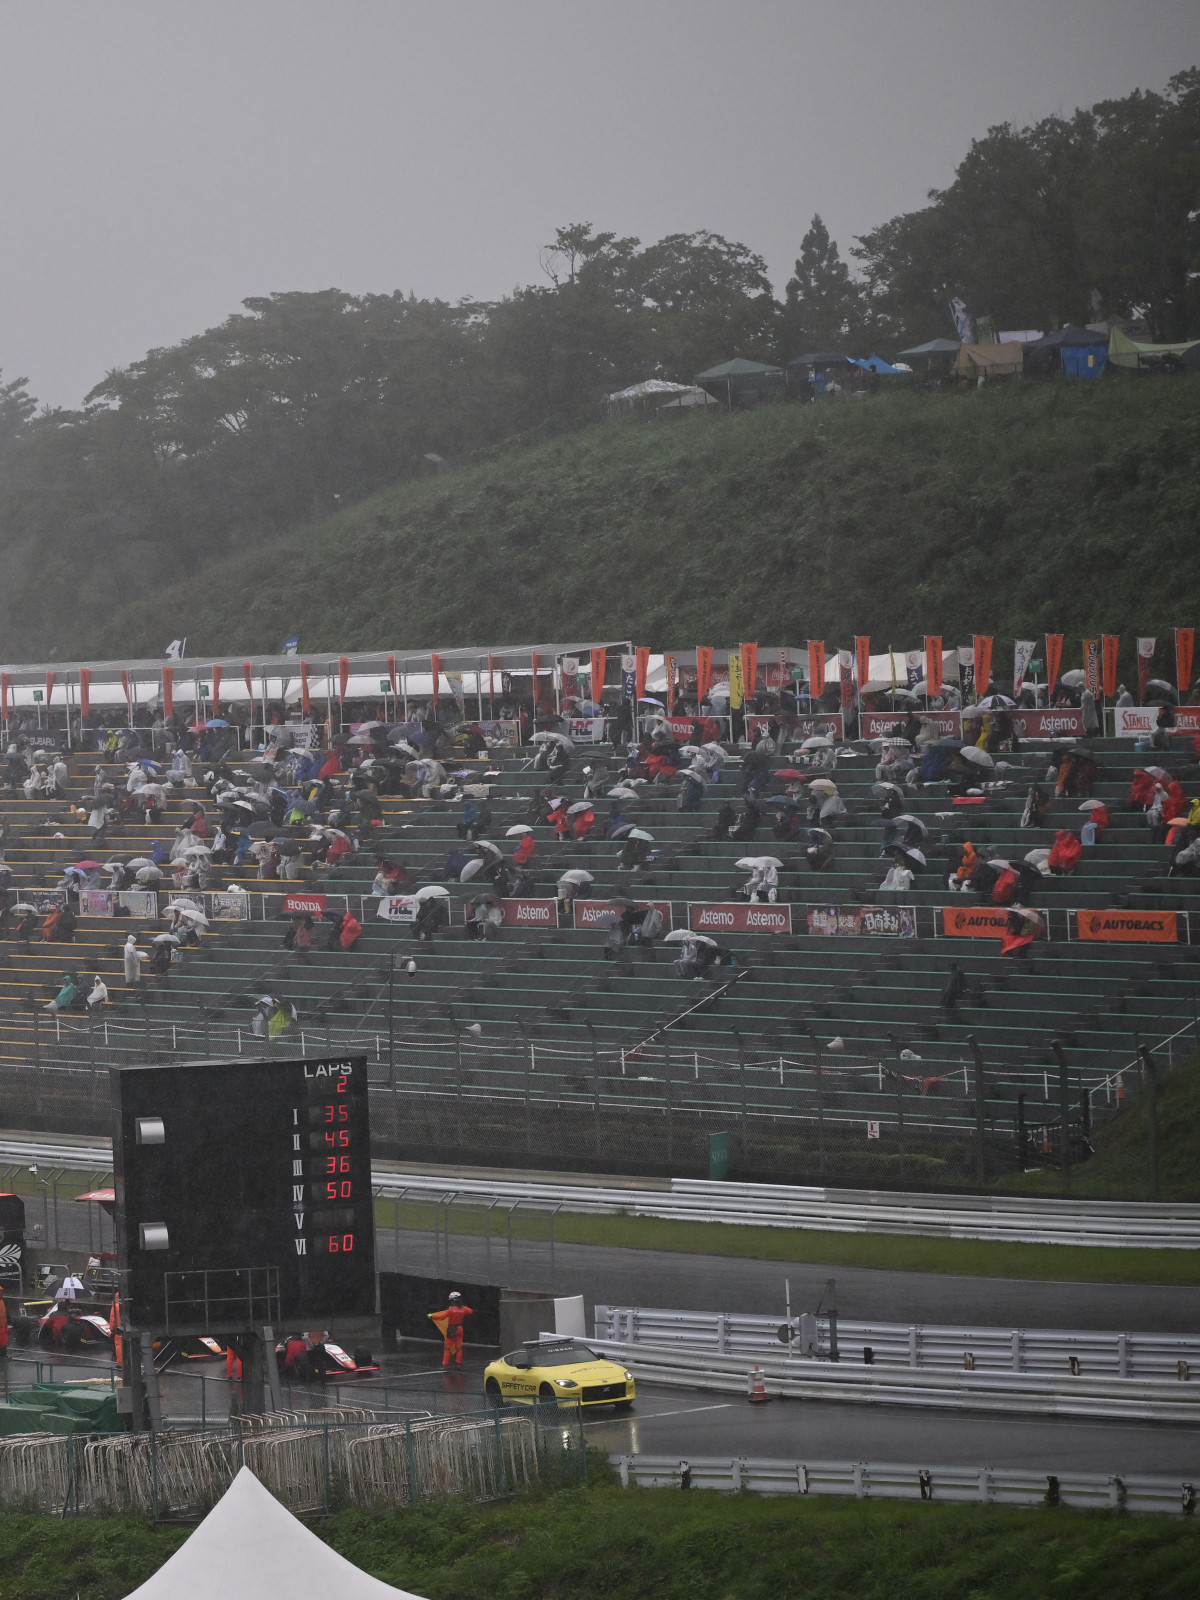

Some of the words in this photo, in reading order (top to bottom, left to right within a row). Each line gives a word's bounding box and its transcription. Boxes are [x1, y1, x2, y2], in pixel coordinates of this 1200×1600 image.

[1039, 715, 1078, 731] Astemo
[1122, 711, 1152, 730] STANLEY
[287, 899, 322, 912] HONDA
[516, 904, 550, 919] Astemo
[699, 908, 734, 925] Astemo
[746, 911, 785, 926] Astemo
[1103, 919, 1164, 931] AUTOBACS
[303, 1061, 353, 1078] LAPS
[336, 1075, 348, 1093] 2
[324, 1104, 349, 1122] 35
[324, 1129, 350, 1148] 45
[326, 1155, 350, 1174] 36
[327, 1180, 352, 1199] 50
[294, 1212, 305, 1230] V
[328, 1233, 354, 1253] 60
[501, 1381, 525, 1392] SAFETY
[525, 1384, 537, 1392] CAR
